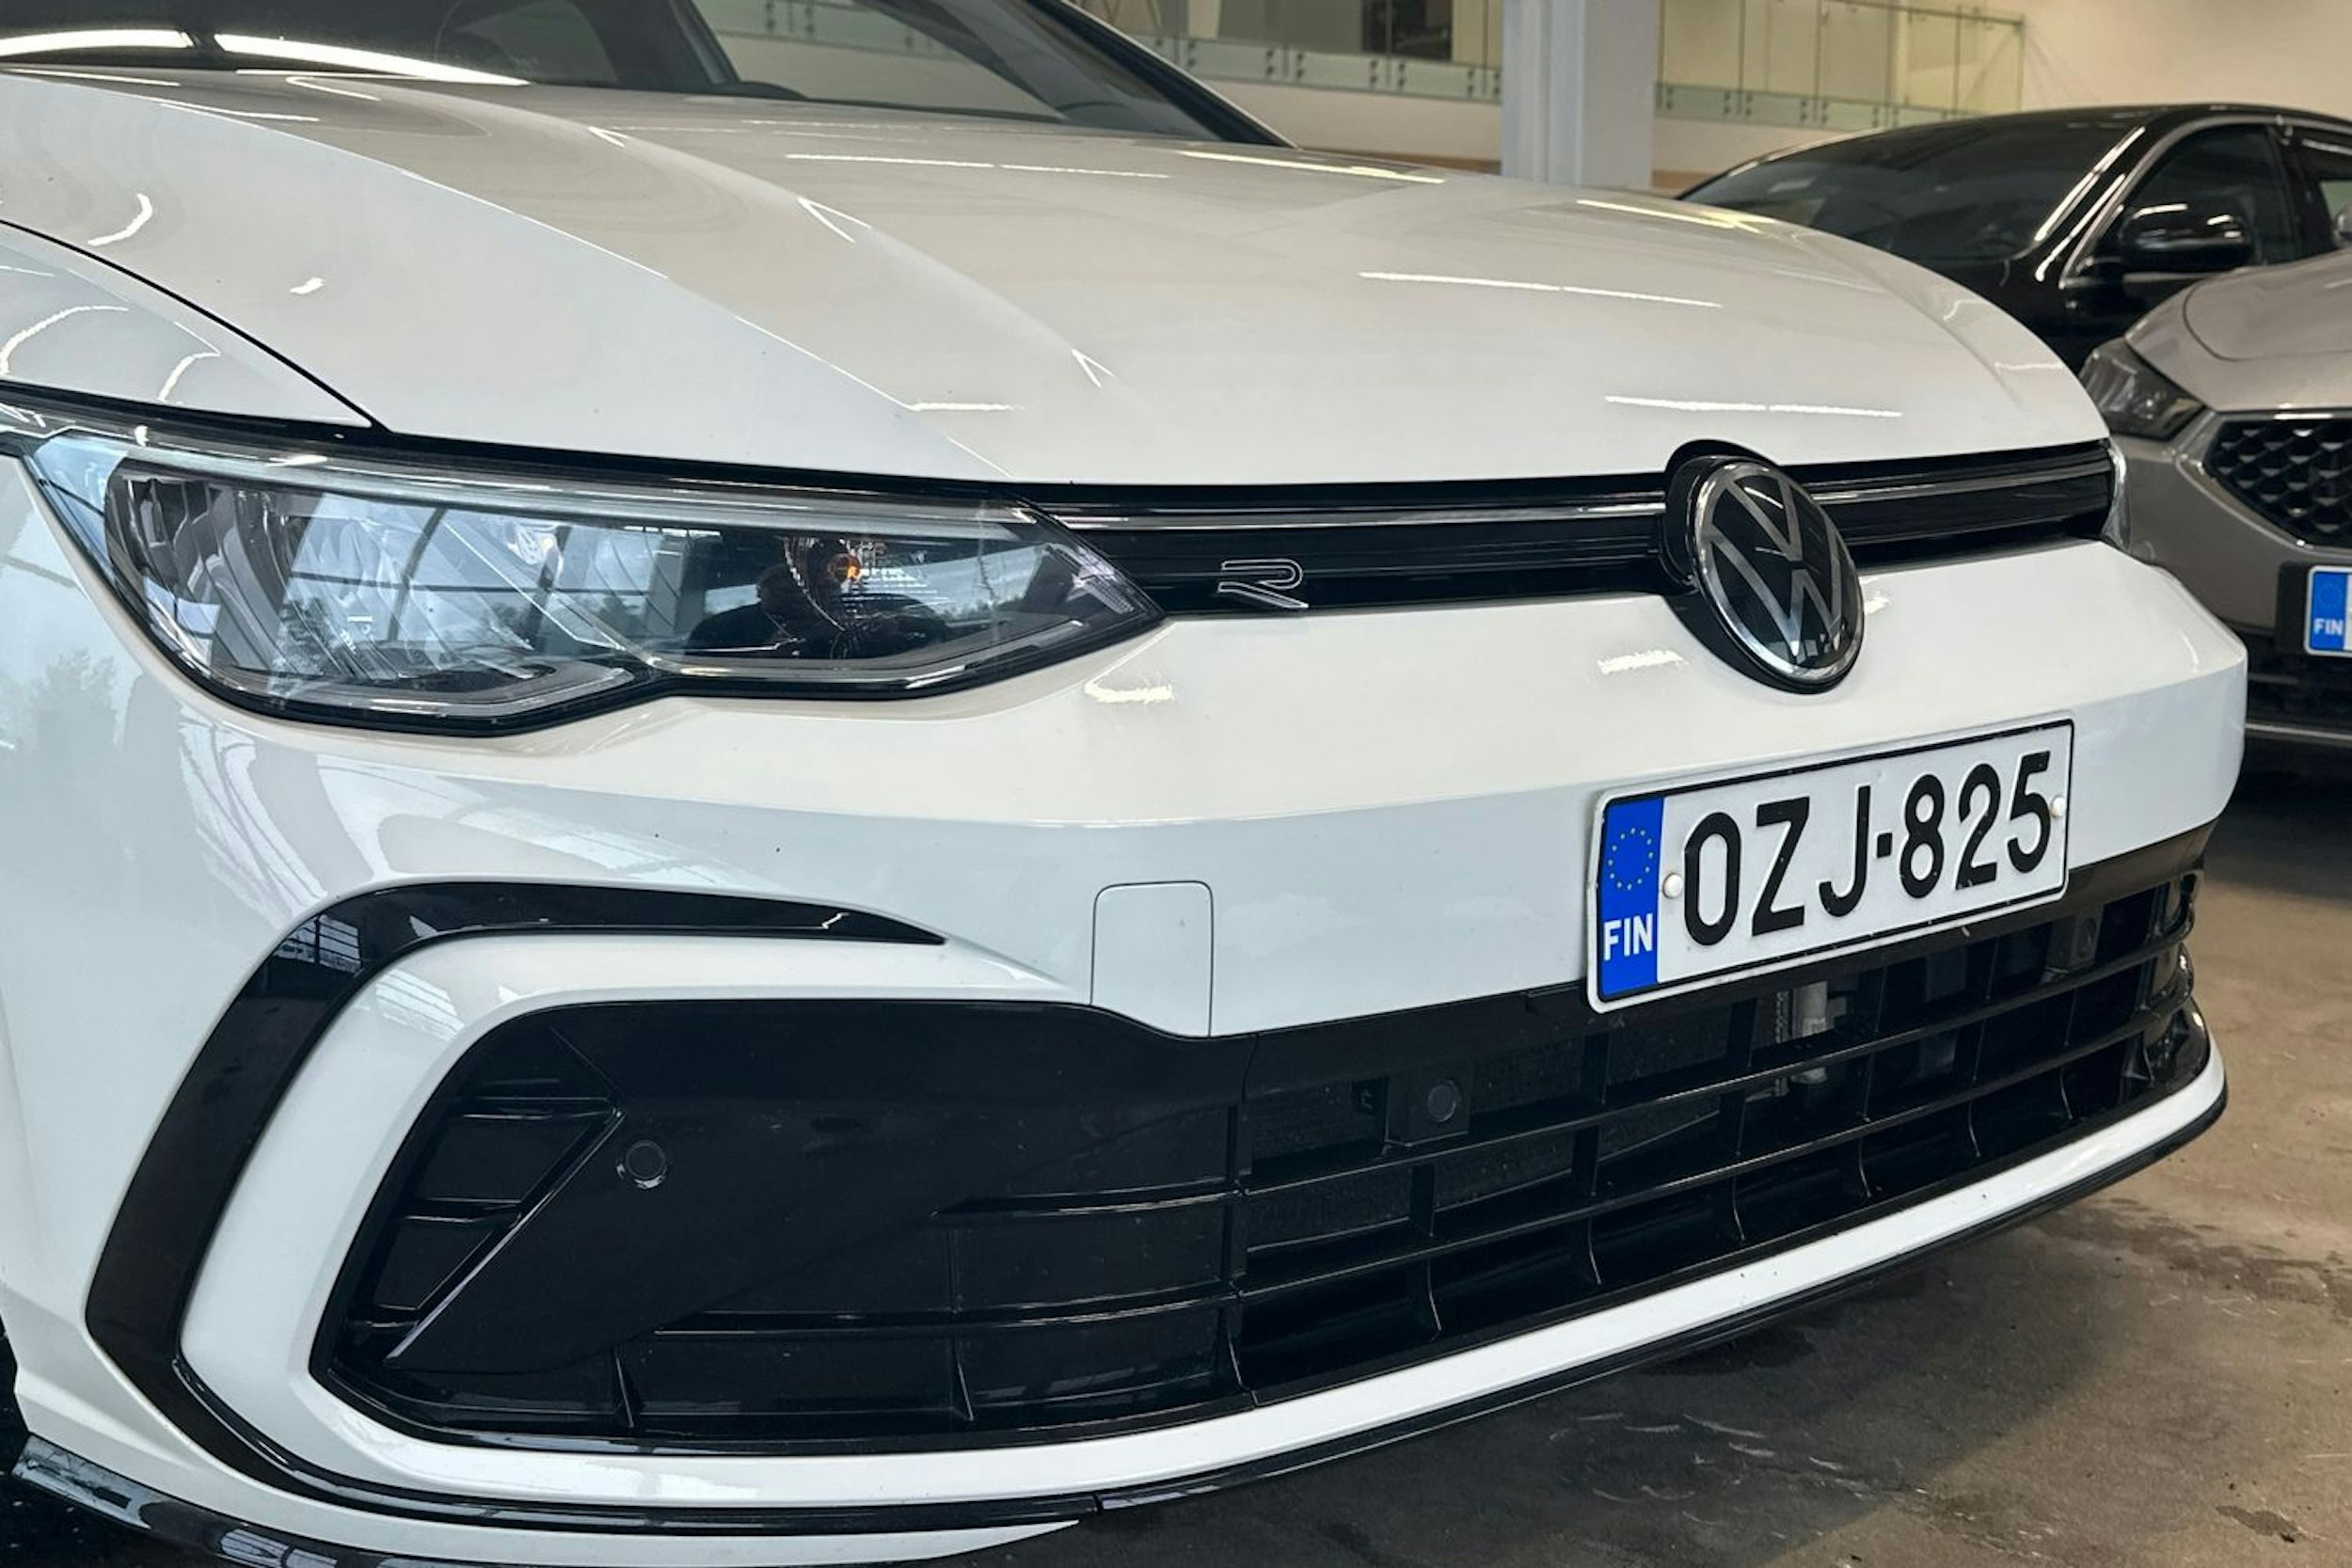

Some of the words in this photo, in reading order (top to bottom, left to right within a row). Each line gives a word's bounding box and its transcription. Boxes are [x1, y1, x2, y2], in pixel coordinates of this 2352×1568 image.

[1217, 558, 1310, 609] R
[2313, 617, 2344, 636] FIN
[1683, 751, 2052, 946] OZJ-825
[1602, 912, 1655, 961] FIN
